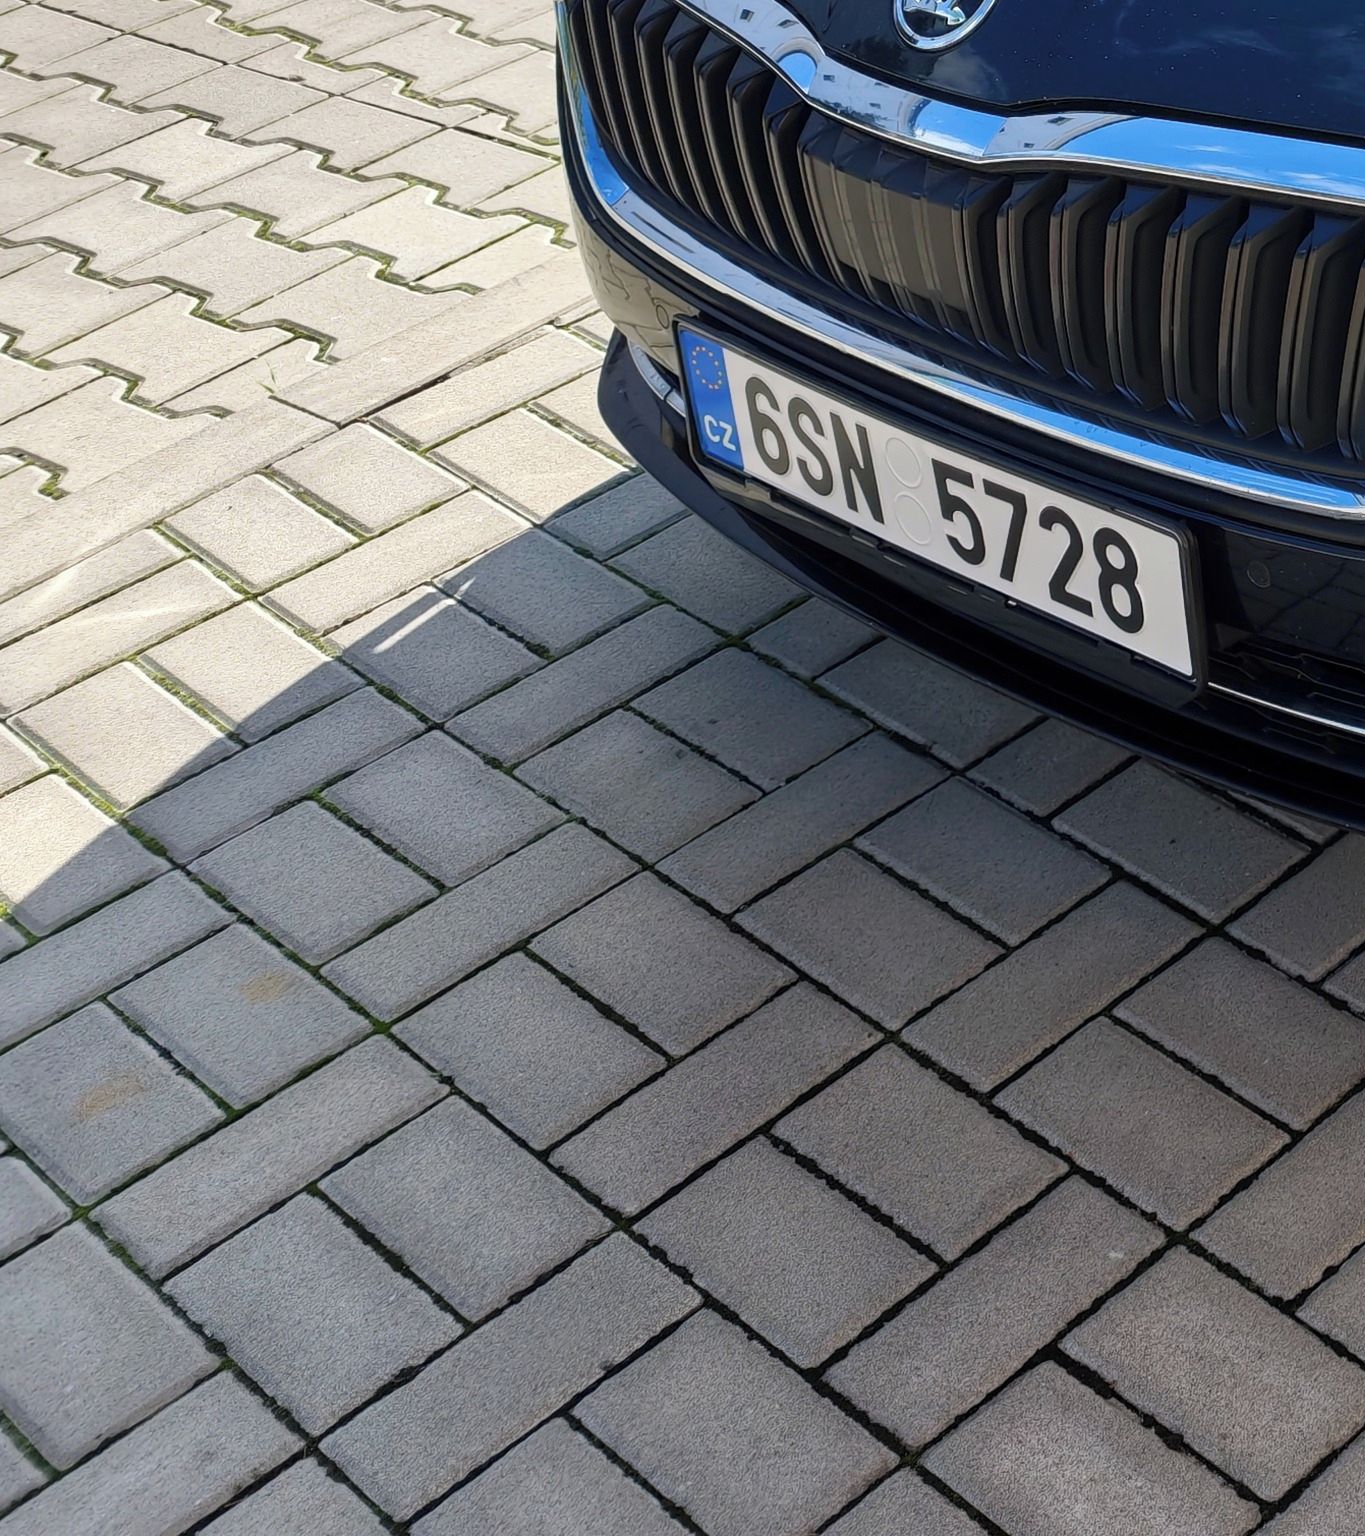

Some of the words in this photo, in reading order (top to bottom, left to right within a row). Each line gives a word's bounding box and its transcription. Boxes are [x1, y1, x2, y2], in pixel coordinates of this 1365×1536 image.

[704, 413, 737, 452] CZ
[745, 375, 885, 525] 6SN
[931, 457, 1145, 634] 5728
